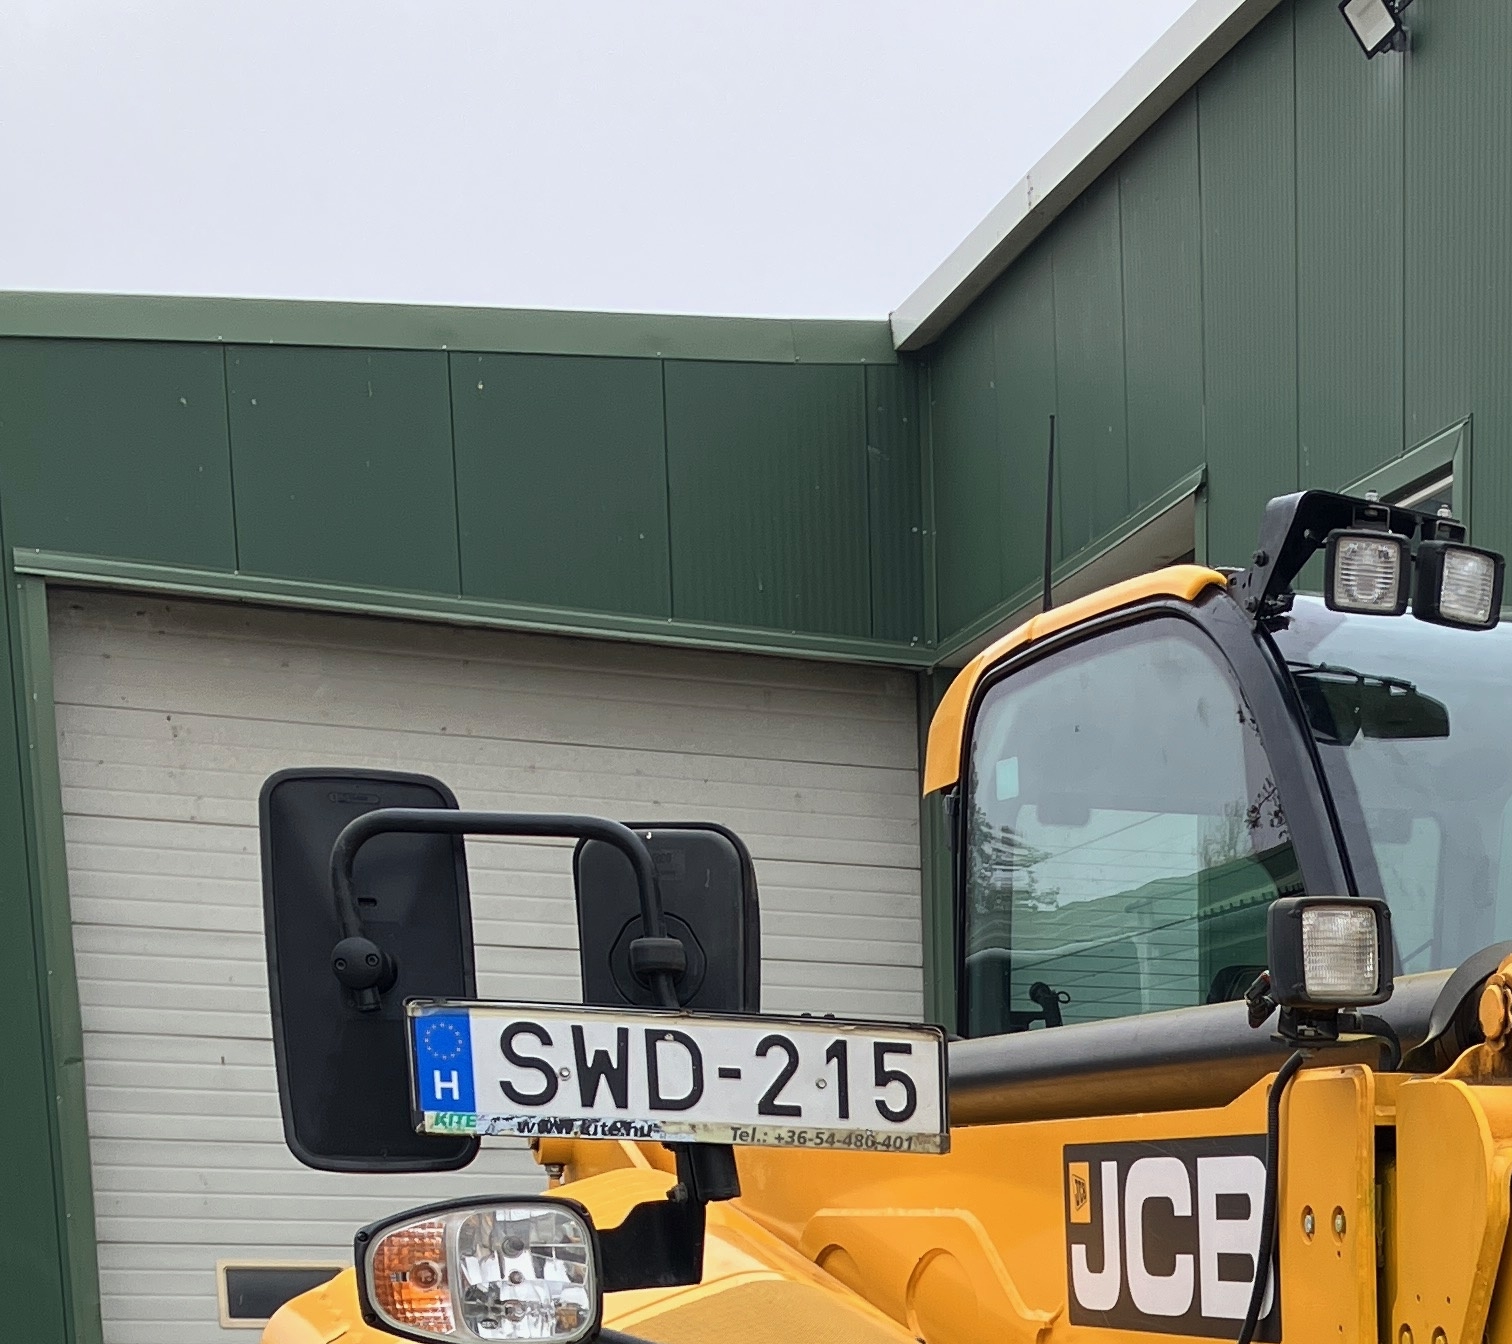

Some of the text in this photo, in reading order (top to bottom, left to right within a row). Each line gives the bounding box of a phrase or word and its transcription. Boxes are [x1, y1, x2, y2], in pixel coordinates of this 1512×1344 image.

[433, 1069, 460, 1101] H
[498, 1021, 918, 1123] SWD-215
[434, 1113, 477, 1128] KITE
[1071, 1156, 1274, 1321] JCB
